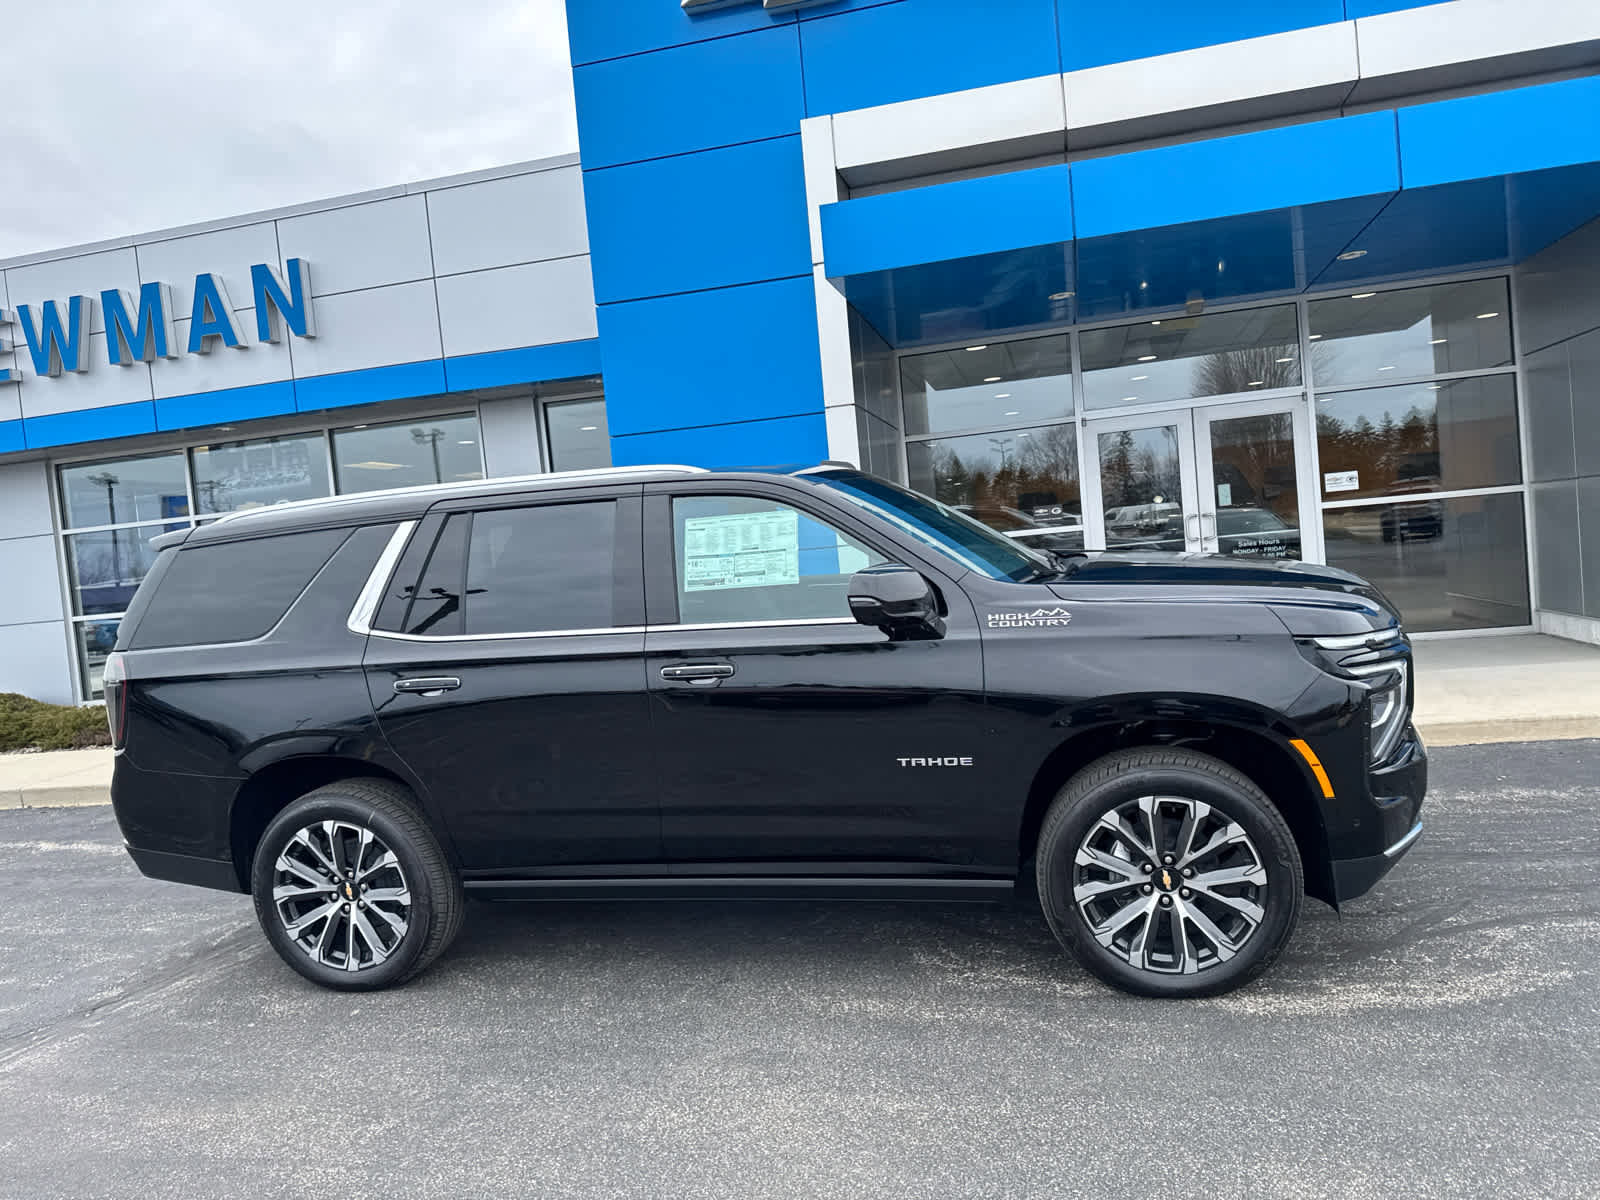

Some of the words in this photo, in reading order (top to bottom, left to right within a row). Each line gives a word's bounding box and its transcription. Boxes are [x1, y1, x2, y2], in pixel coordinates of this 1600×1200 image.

[1259, 538, 1280, 546] Hours
[1233, 546, 1258, 554] MONDAY
[988, 619, 1072, 628] COUNTRY
[896, 757, 973, 767] TAHOE
